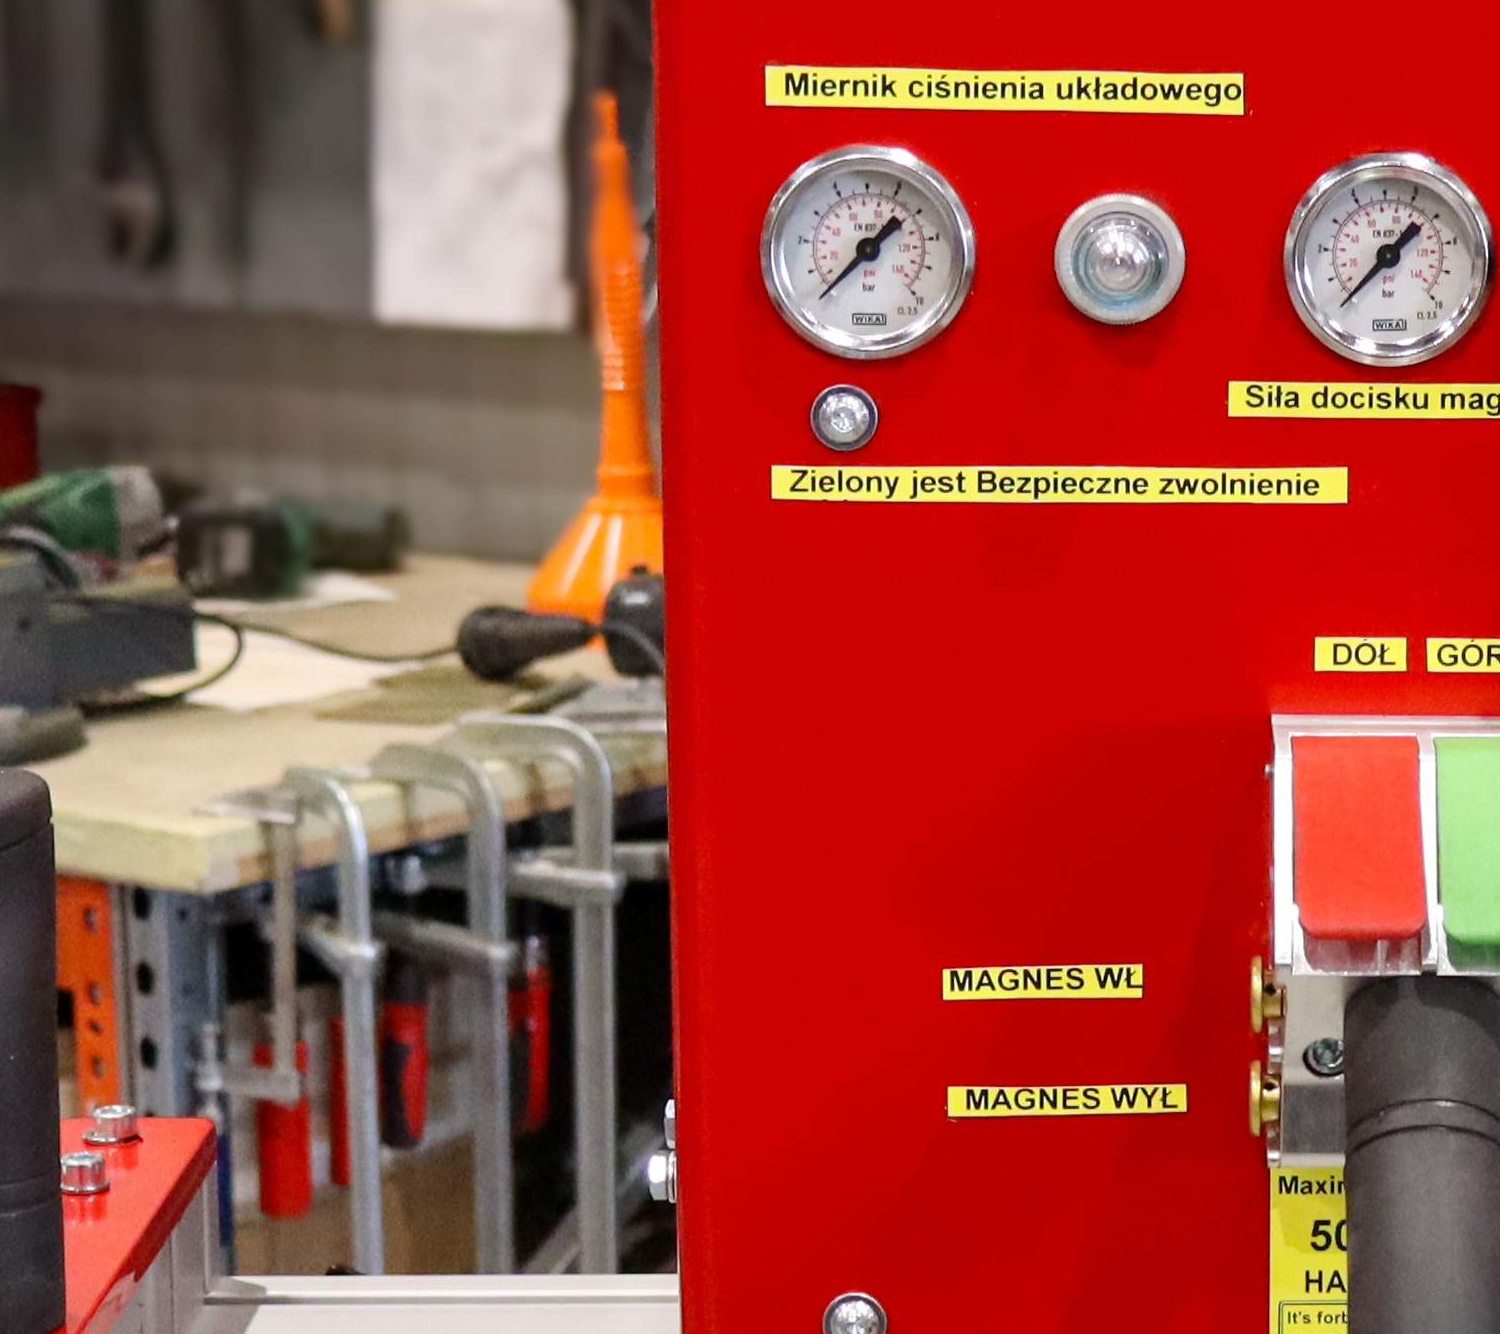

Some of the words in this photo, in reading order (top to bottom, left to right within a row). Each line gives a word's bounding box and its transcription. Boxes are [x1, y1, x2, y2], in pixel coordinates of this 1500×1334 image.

[784, 71, 897, 99] Miernik
[908, 73, 1045, 101] ciśnienia
[1057, 74, 1243, 108] układowego
[1244, 383, 1301, 410] Siła
[1311, 384, 1430, 411] docisku
[788, 468, 901, 499] Zielony
[907, 470, 969, 499] jest
[977, 470, 1149, 500] Bezpieczne
[1159, 471, 1321, 497] zwolnienie
[1331, 639, 1397, 666] DÓŁ
[948, 968, 1086, 992] MAGNES
[1094, 967, 1143, 990] WŁ
[965, 1087, 1102, 1111] MAGNES
[1111, 1086, 1180, 1110] WYŁ
[1278, 1175, 1344, 1195] Maxi
[1309, 1218, 1348, 1253] 50
[1304, 1269, 1348, 1294] HA
[1286, 1310, 1311, 1325] It's
[1317, 1310, 1349, 1325] forb
